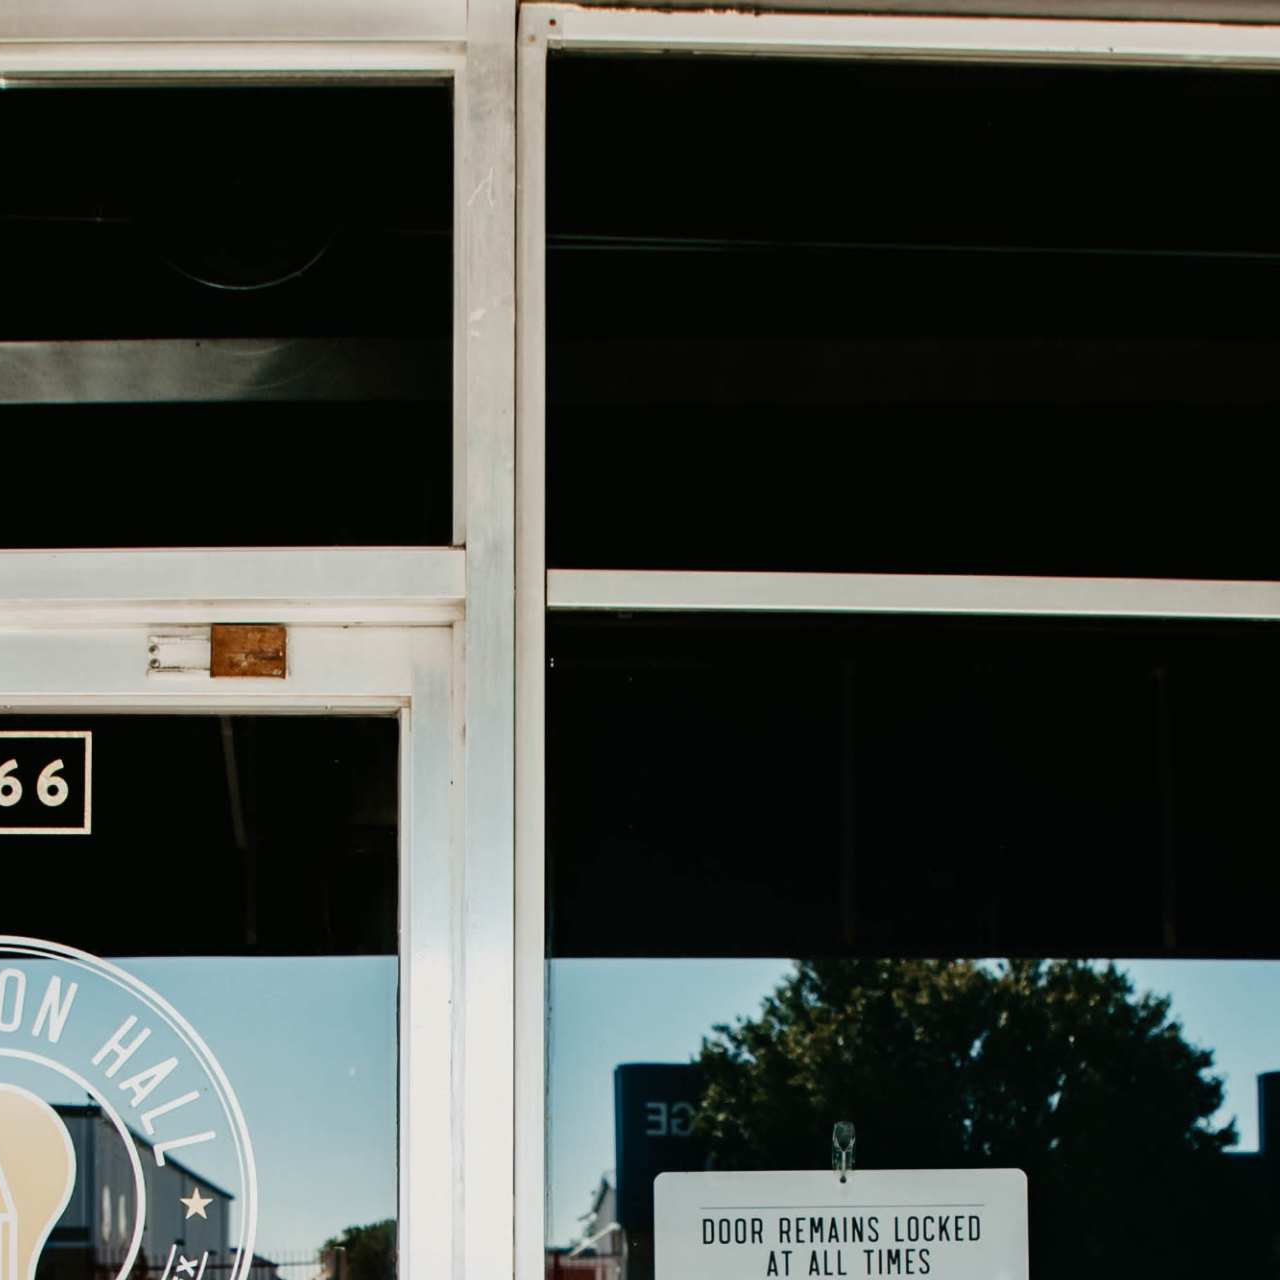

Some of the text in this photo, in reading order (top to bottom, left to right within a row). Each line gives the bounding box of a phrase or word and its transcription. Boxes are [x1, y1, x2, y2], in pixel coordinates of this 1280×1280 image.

[90, 1014, 217, 1167] HALL
[701, 1215, 982, 1245] DOOR REMAINS LOCKED
[766, 1248, 931, 1277] AT ALL TIMES
